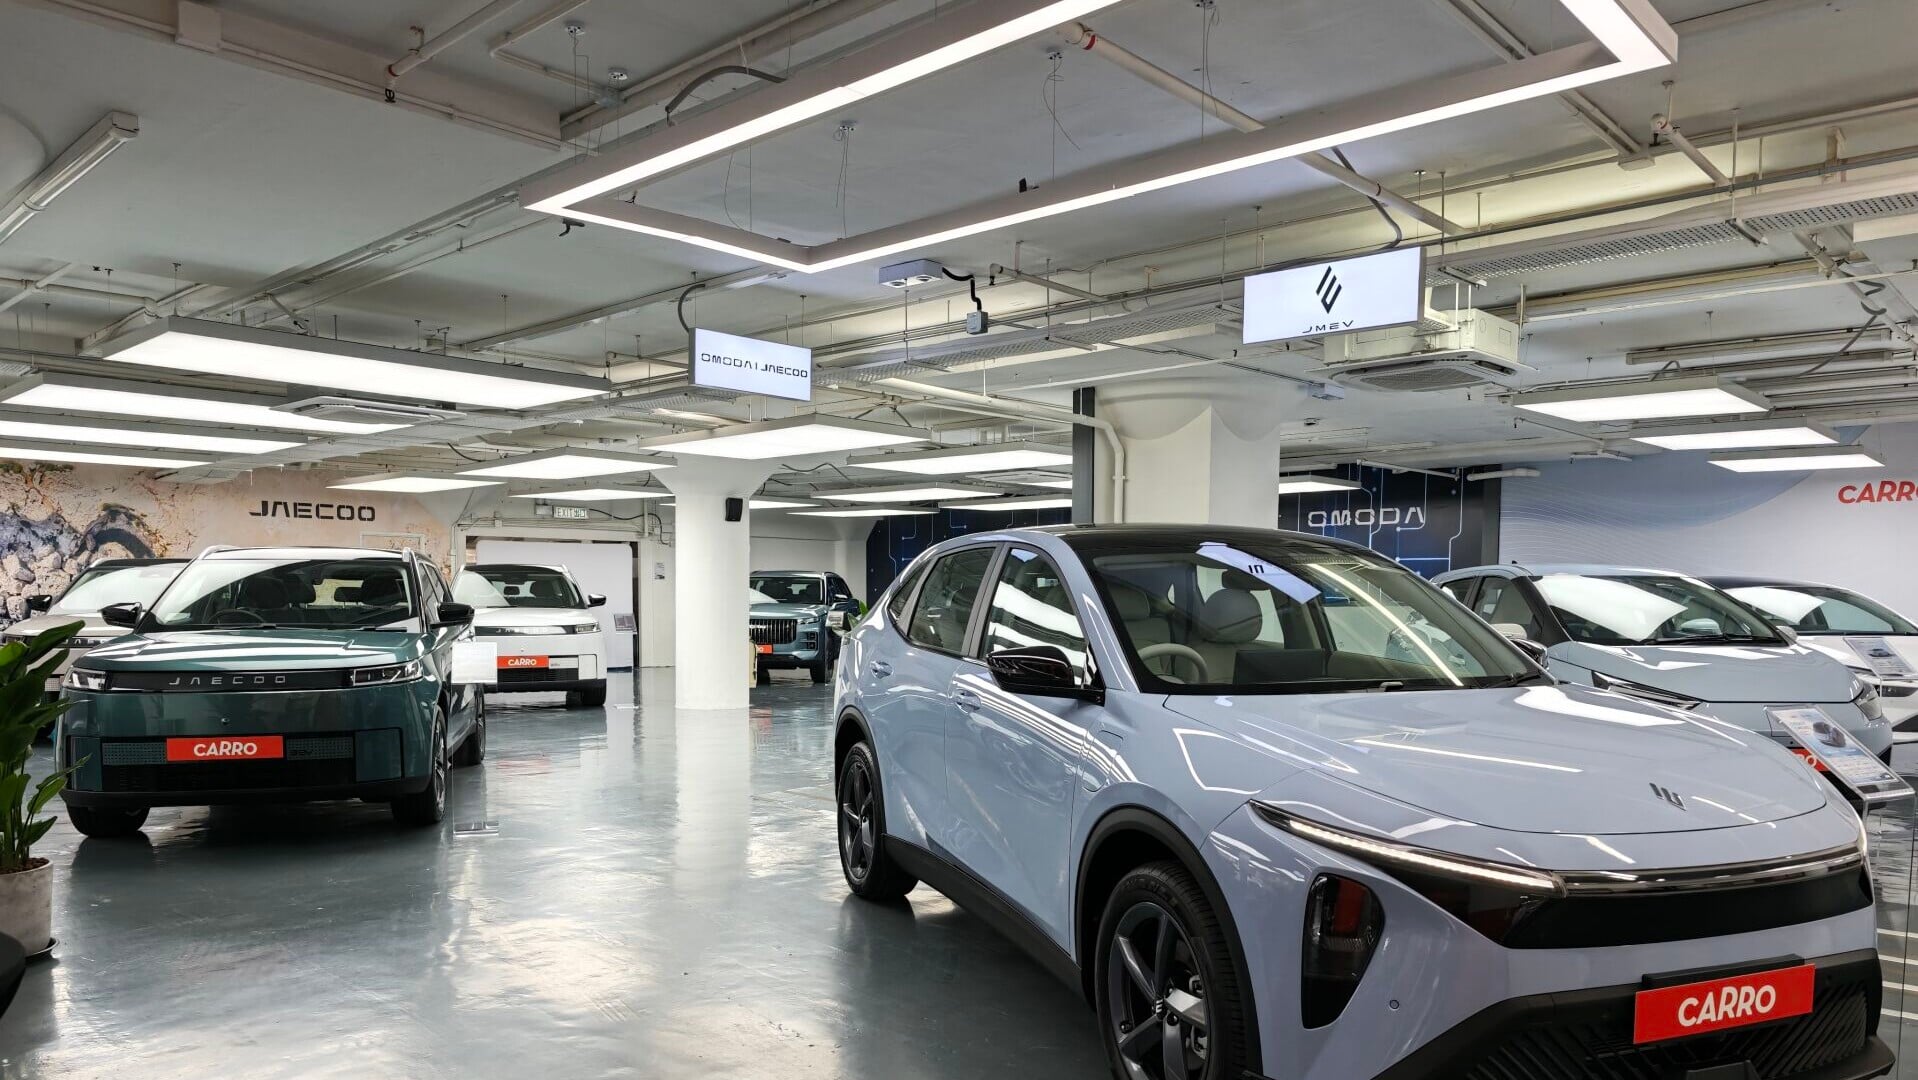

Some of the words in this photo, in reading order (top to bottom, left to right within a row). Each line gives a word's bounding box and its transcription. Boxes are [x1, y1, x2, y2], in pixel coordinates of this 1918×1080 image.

[1302, 320, 1354, 333] JMEV
[701, 353, 752, 369] OMODA
[761, 364, 808, 378] JAECOO
[1838, 480, 1918, 503] CARR
[249, 500, 376, 521] JAECOO
[1307, 507, 1424, 527] OMODA
[508, 657, 537, 666] CARRO
[169, 676, 285, 685] JAECOO
[193, 740, 258, 757] CARRO
[1678, 985, 1776, 1027] CARRO
